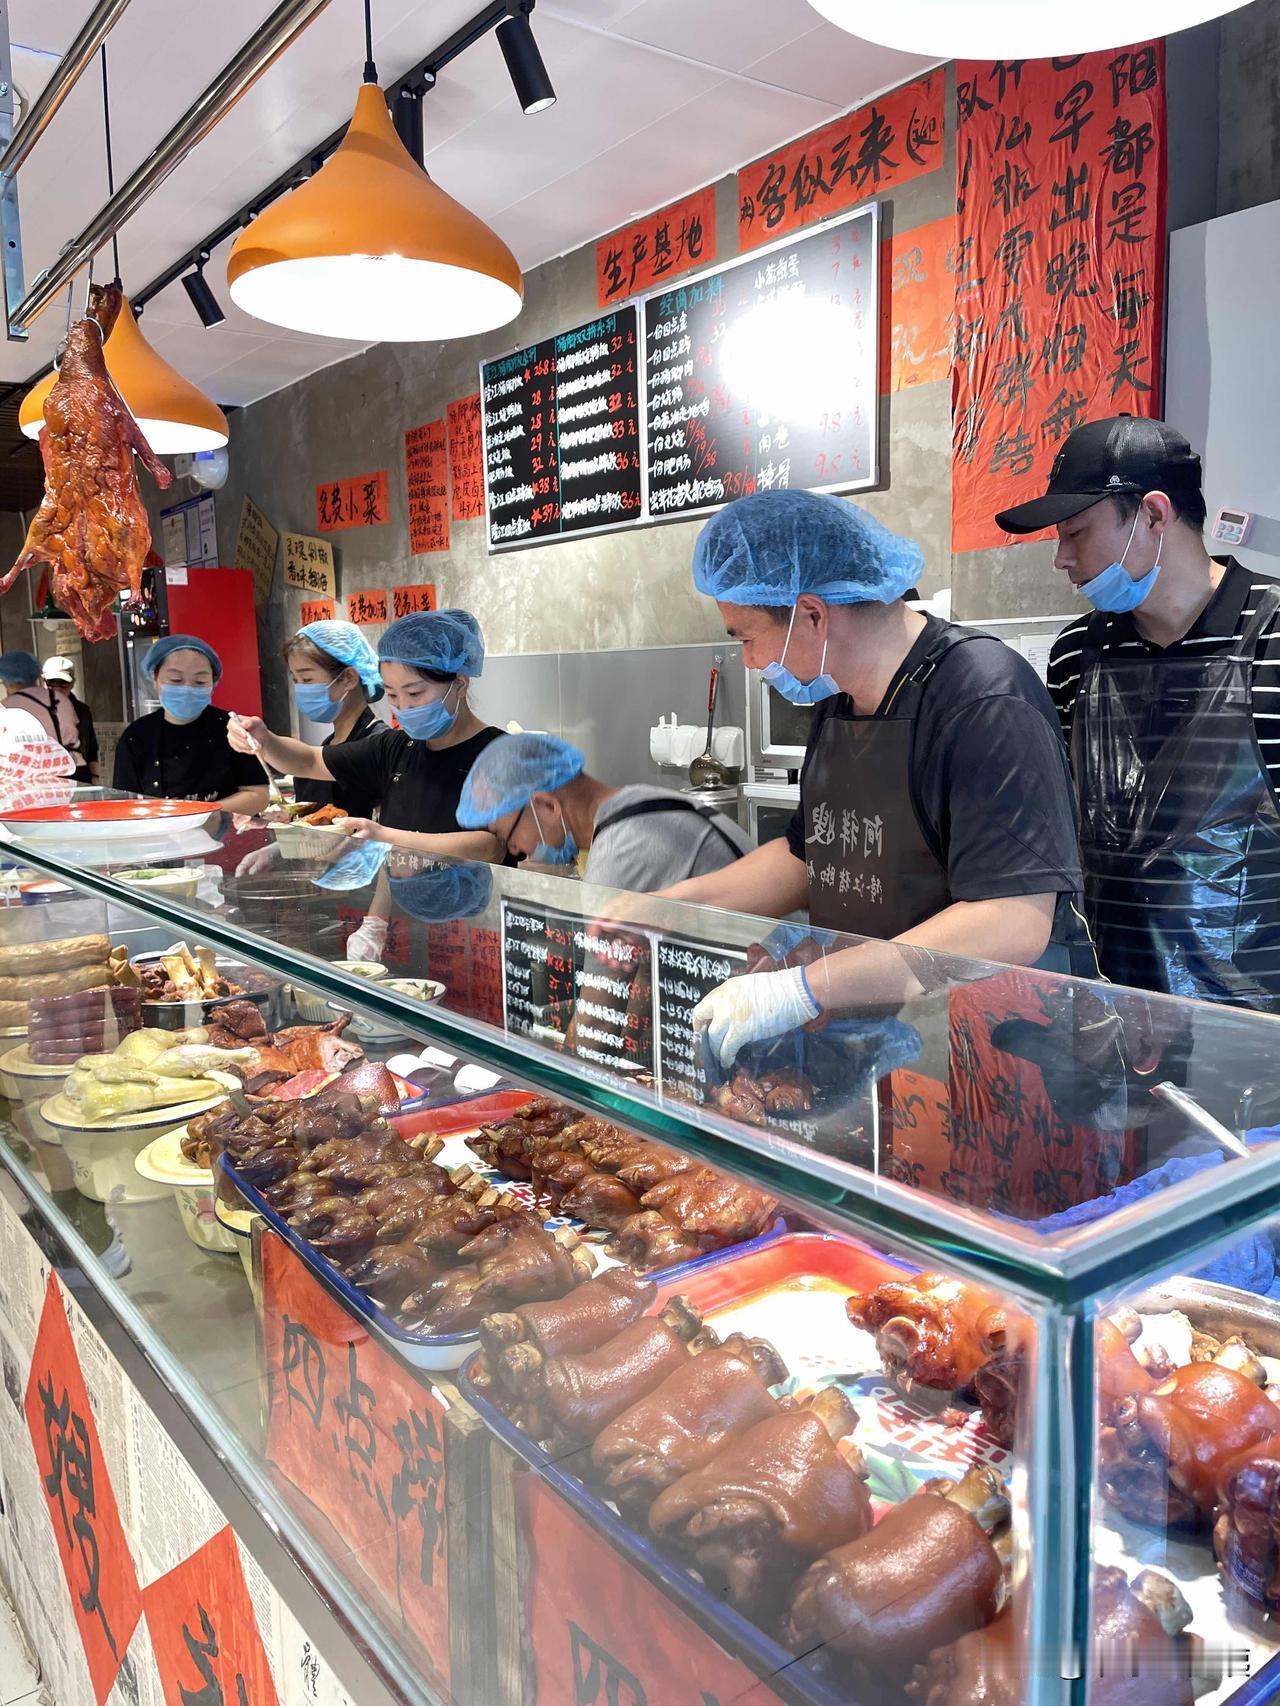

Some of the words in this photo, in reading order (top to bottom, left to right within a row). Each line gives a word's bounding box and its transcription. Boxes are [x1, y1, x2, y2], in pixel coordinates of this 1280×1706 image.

[602, 215, 704, 299] 生产基地
[611, 336, 623, 353] 32
[611, 364, 622, 380] 32
[612, 420, 625, 438] 33
[531, 432, 542, 452] 29
[616, 452, 629, 470] 36
[320, 480, 381, 525] 免费小菜
[622, 491, 634, 509] 36
